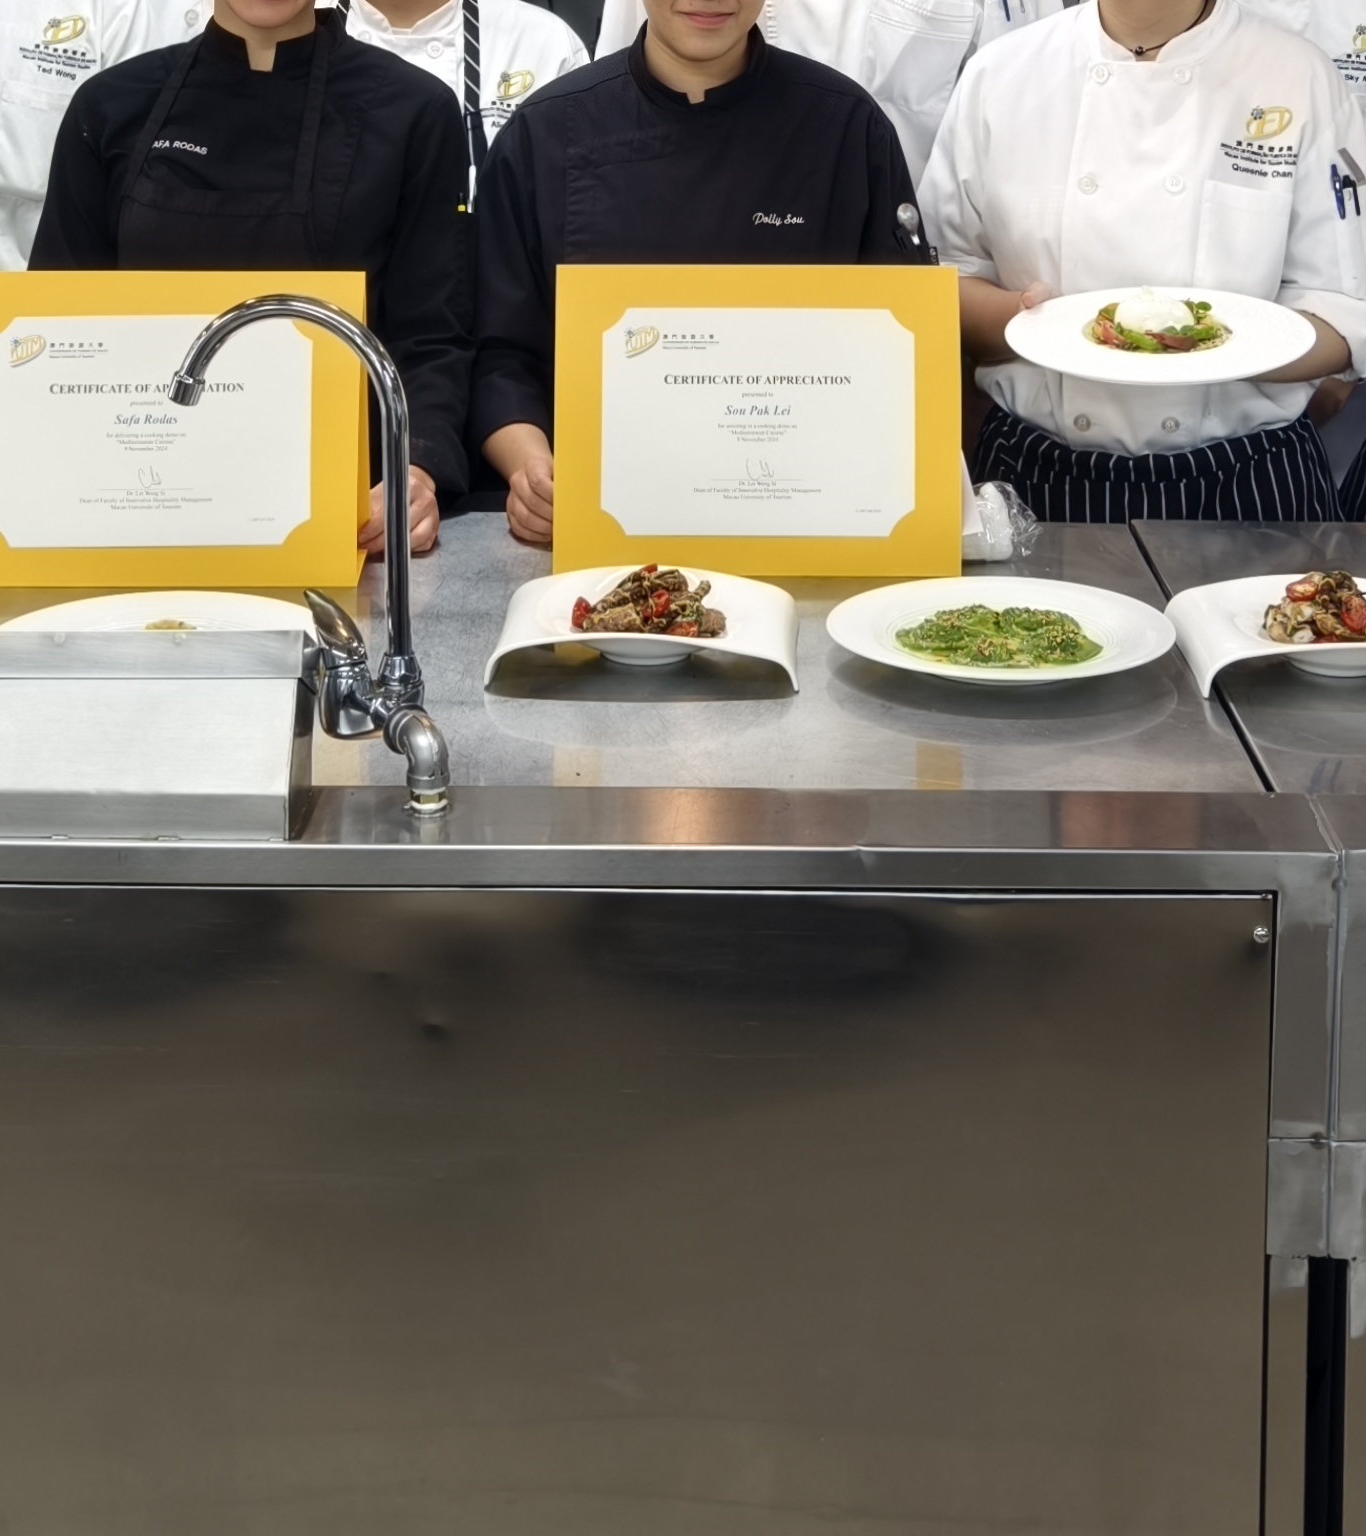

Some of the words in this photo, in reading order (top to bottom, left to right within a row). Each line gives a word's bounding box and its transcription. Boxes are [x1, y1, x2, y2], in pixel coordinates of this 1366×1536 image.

[37, 65, 53, 75] Ted
[152, 139, 170, 149] AFA
[172, 140, 208, 156] RODAS
[1231, 162, 1269, 177] Queenie
[1271, 169, 1293, 178] Chan
[663, 374, 743, 385] CERTIFICATE
[746, 375, 761, 385] OF
[764, 375, 852, 386] APPRECIATION
[49, 383, 132, 394] CERTIFICATE
[135, 383, 151, 394] OF
[741, 391, 768, 399] presented
[724, 405, 746, 416] Sou
[749, 405, 771, 416] Pak
[773, 405, 791, 416] Lei
[113, 413, 140, 427] Safa
[143, 413, 178, 425] Rodas
